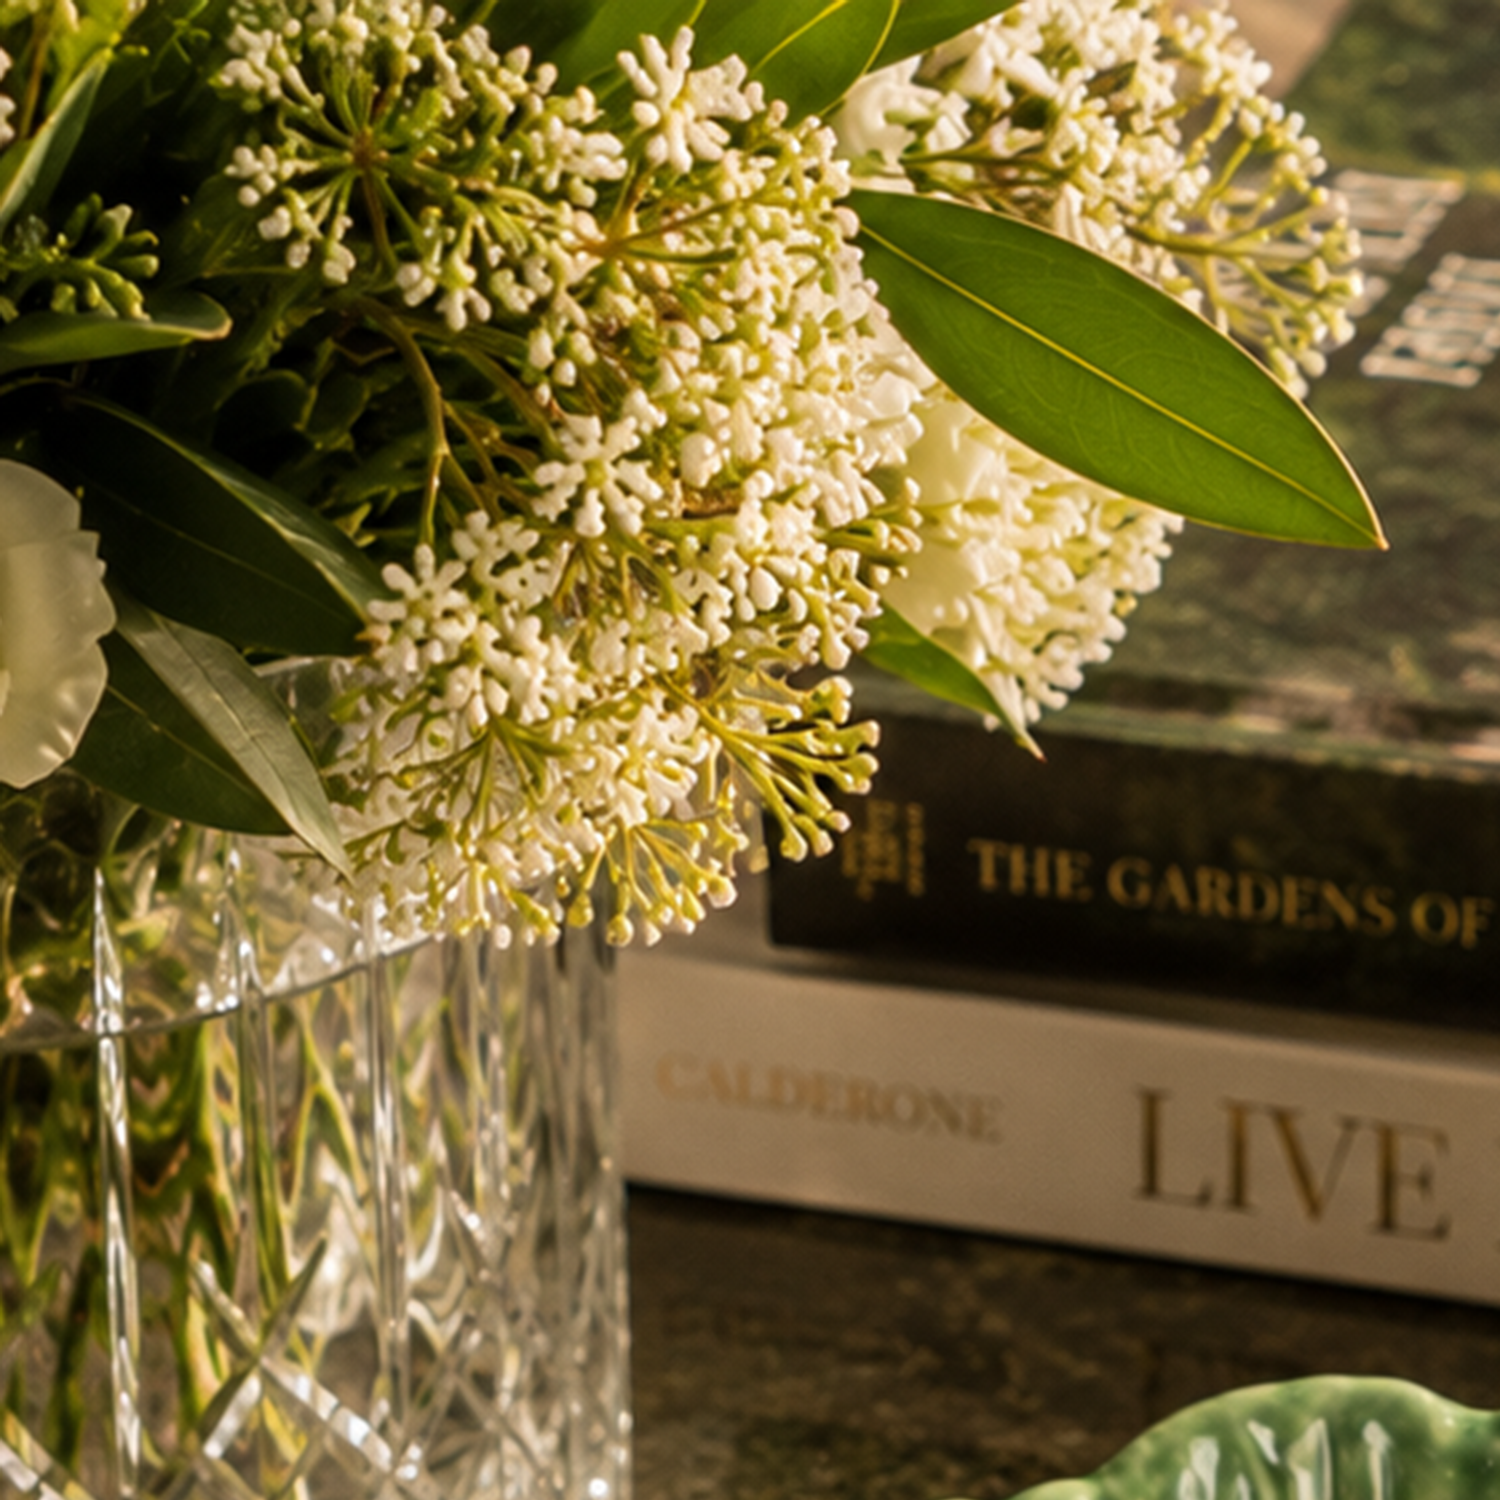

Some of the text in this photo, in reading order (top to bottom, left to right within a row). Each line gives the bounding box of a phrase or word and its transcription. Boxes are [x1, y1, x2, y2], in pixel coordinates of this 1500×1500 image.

[970, 841, 1090, 900] THE
[1109, 859, 1395, 934] GARDENS
[1410, 890, 1494, 950] OF
[655, 1052, 1003, 1143] CALDERONE
[1135, 1087, 1449, 1240] LIVE
